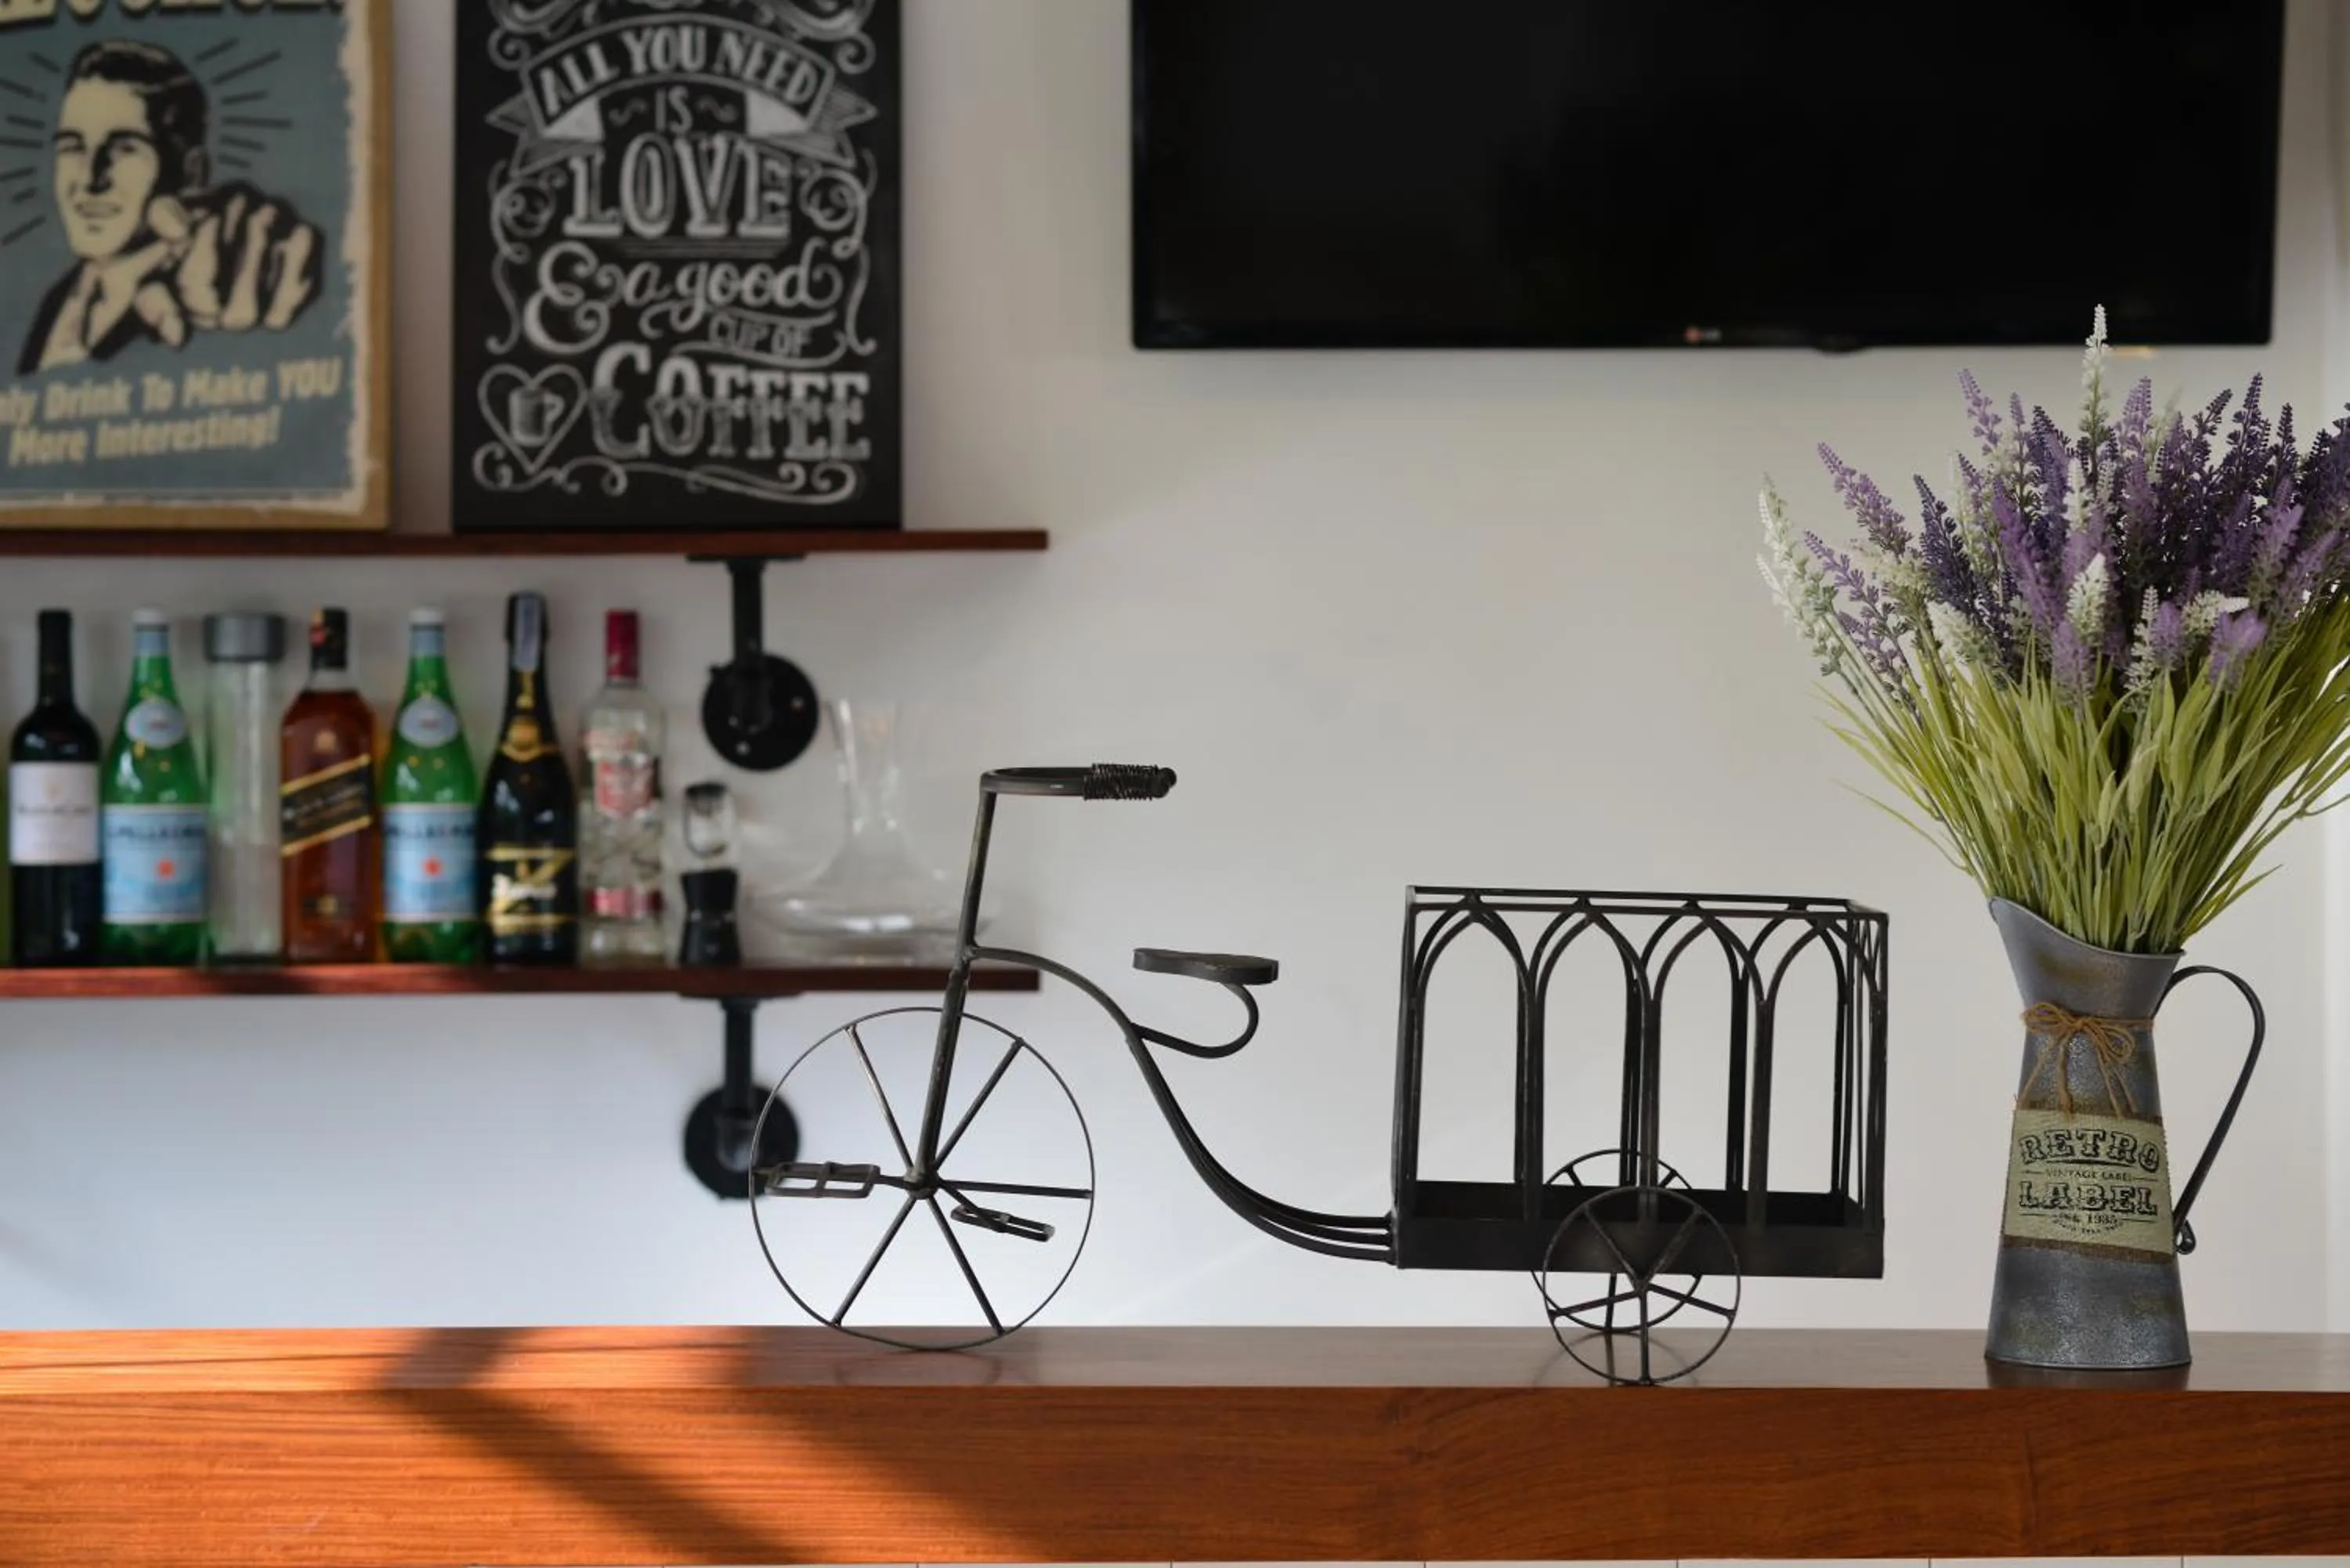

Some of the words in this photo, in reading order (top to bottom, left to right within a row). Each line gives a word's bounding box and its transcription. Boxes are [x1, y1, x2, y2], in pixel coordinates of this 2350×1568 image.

[541, 41, 619, 115] ALL
[624, 25, 706, 74] YOU
[714, 31, 818, 105] NEED
[656, 86, 692, 132] IS
[563, 133, 791, 237] LOVE
[627, 262, 675, 306] a
[641, 239, 844, 338] good
[710, 314, 765, 347] CUP
[772, 325, 812, 358] OF
[45, 378, 132, 421] Drink
[143, 372, 175, 411] To
[183, 364, 268, 408] Make
[278, 357, 342, 400] YOU
[590, 342, 870, 460] COFFEE
[9, 428, 89, 465] More
[95, 404, 282, 458] Interesting!
[2019, 1129, 2160, 1173] RETRO
[2019, 1180, 2158, 1216] LABEL
